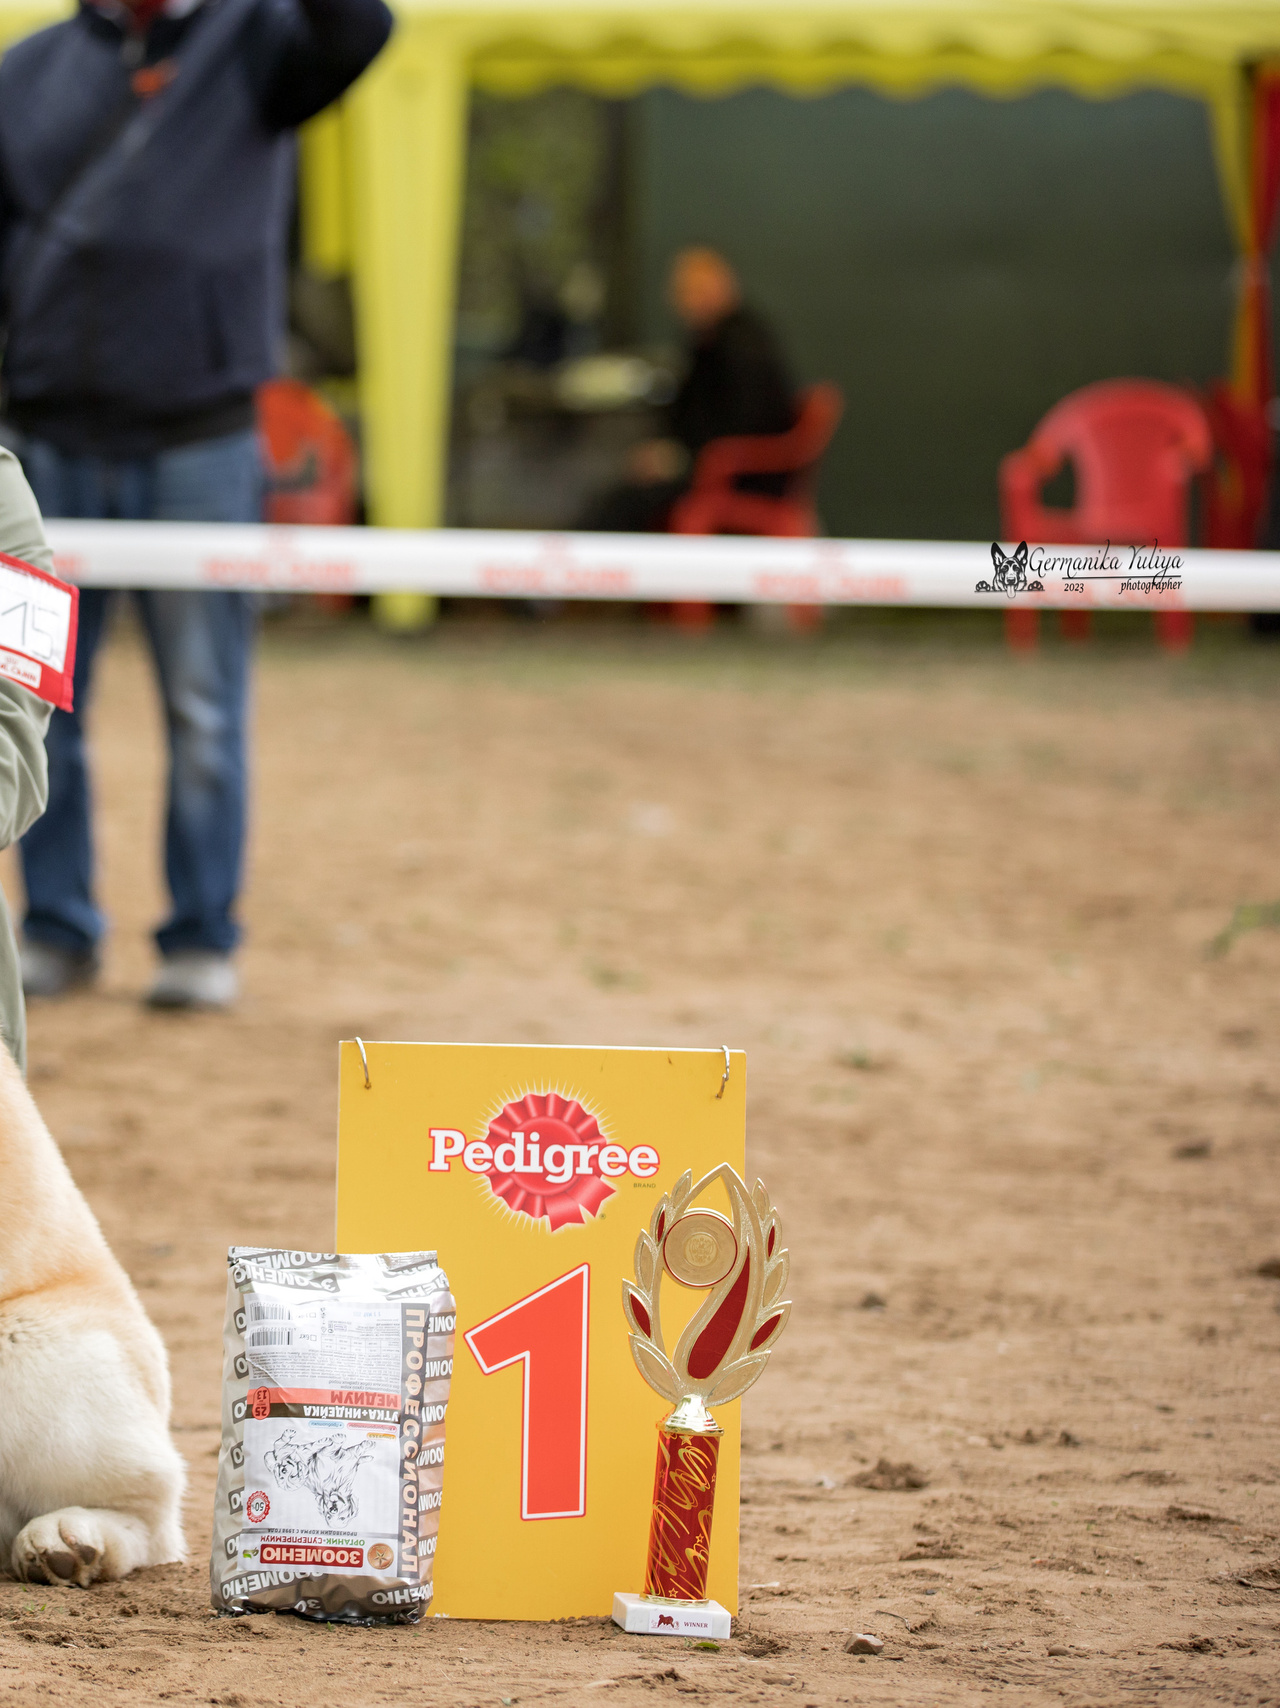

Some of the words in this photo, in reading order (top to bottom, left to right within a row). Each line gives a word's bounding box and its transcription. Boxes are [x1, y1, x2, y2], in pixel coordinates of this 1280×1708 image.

[427, 1127, 661, 1184] Pedigree
[256, 1390, 268, 1400] 13
[330, 1390, 398, 1408] МЕДИУМ
[463, 1262, 591, 1521] 1
[255, 1406, 267, 1417] 25
[401, 1308, 426, 1573] ПРОФЕССИОНАЛ
[262, 1546, 361, 1565] ЗООМЕНЮ
[683, 1621, 709, 1629] WINNER
